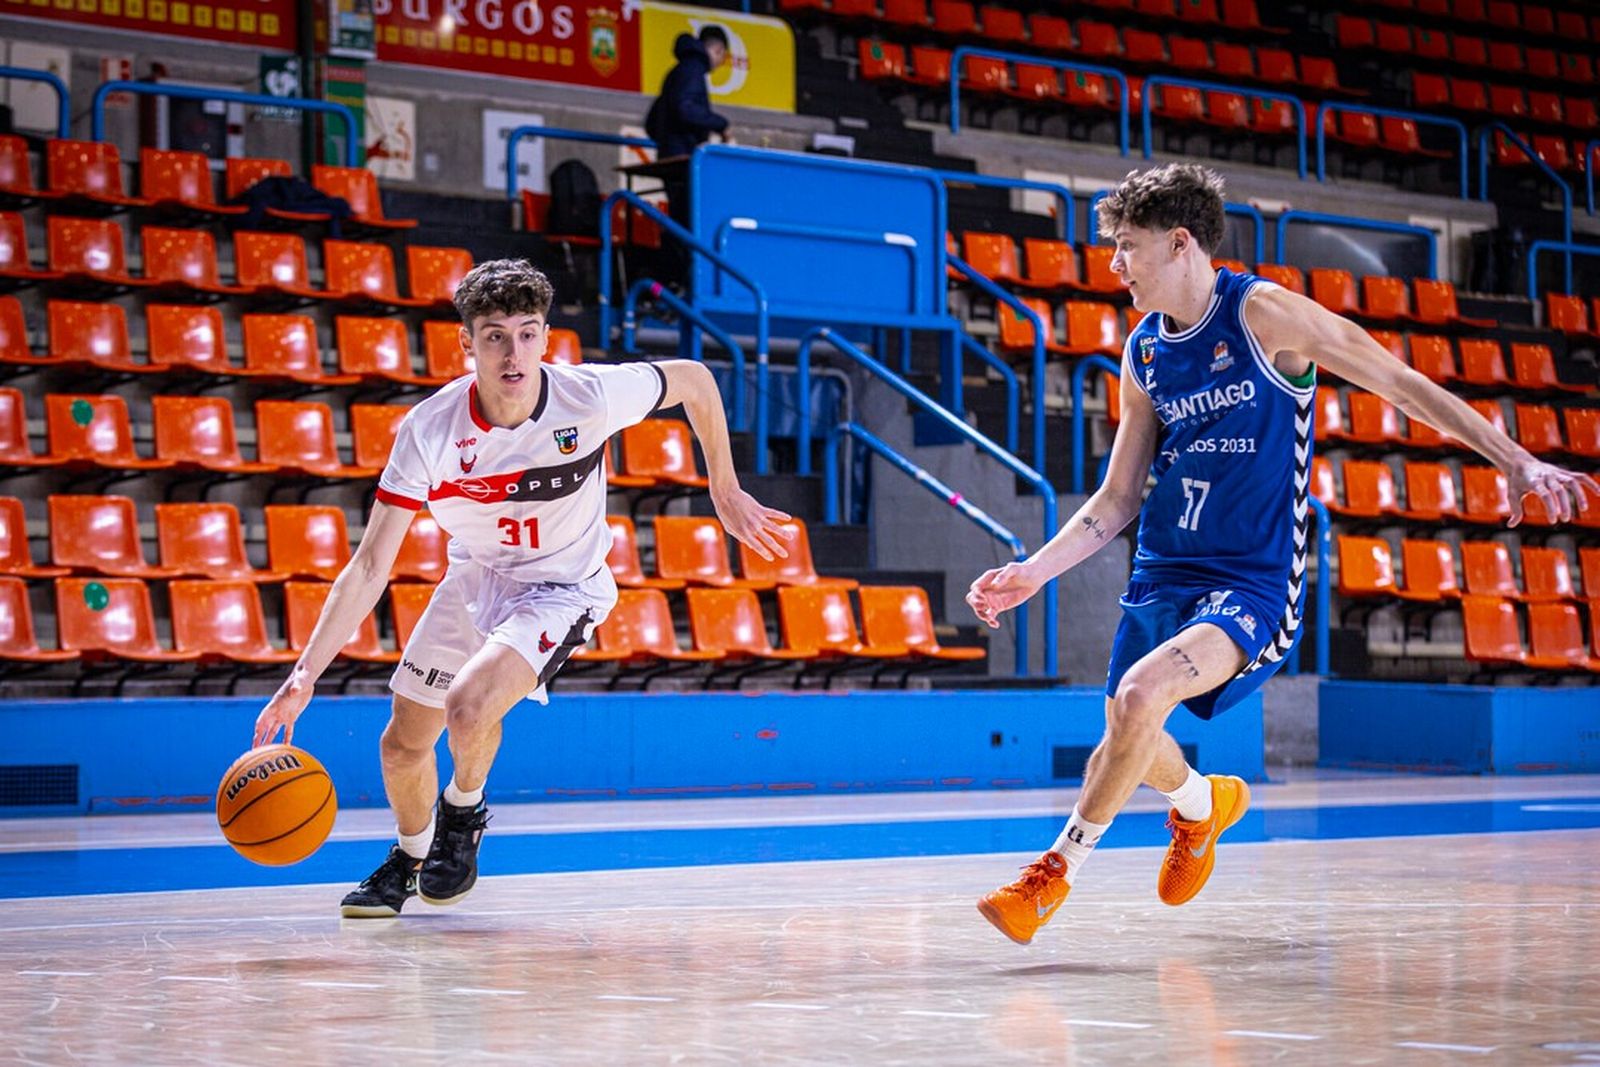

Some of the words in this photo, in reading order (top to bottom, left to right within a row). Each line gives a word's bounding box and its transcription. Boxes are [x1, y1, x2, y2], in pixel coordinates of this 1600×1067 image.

[1163, 380, 1255, 422] SANTIAGO
[554, 429, 576, 438] LIGA
[1219, 438, 1256, 453] 2031
[505, 473, 583, 494] OPEL
[1177, 477, 1211, 531] 57
[497, 516, 539, 549] 31
[403, 659, 425, 677] vive
[226, 754, 301, 800] Wilson
